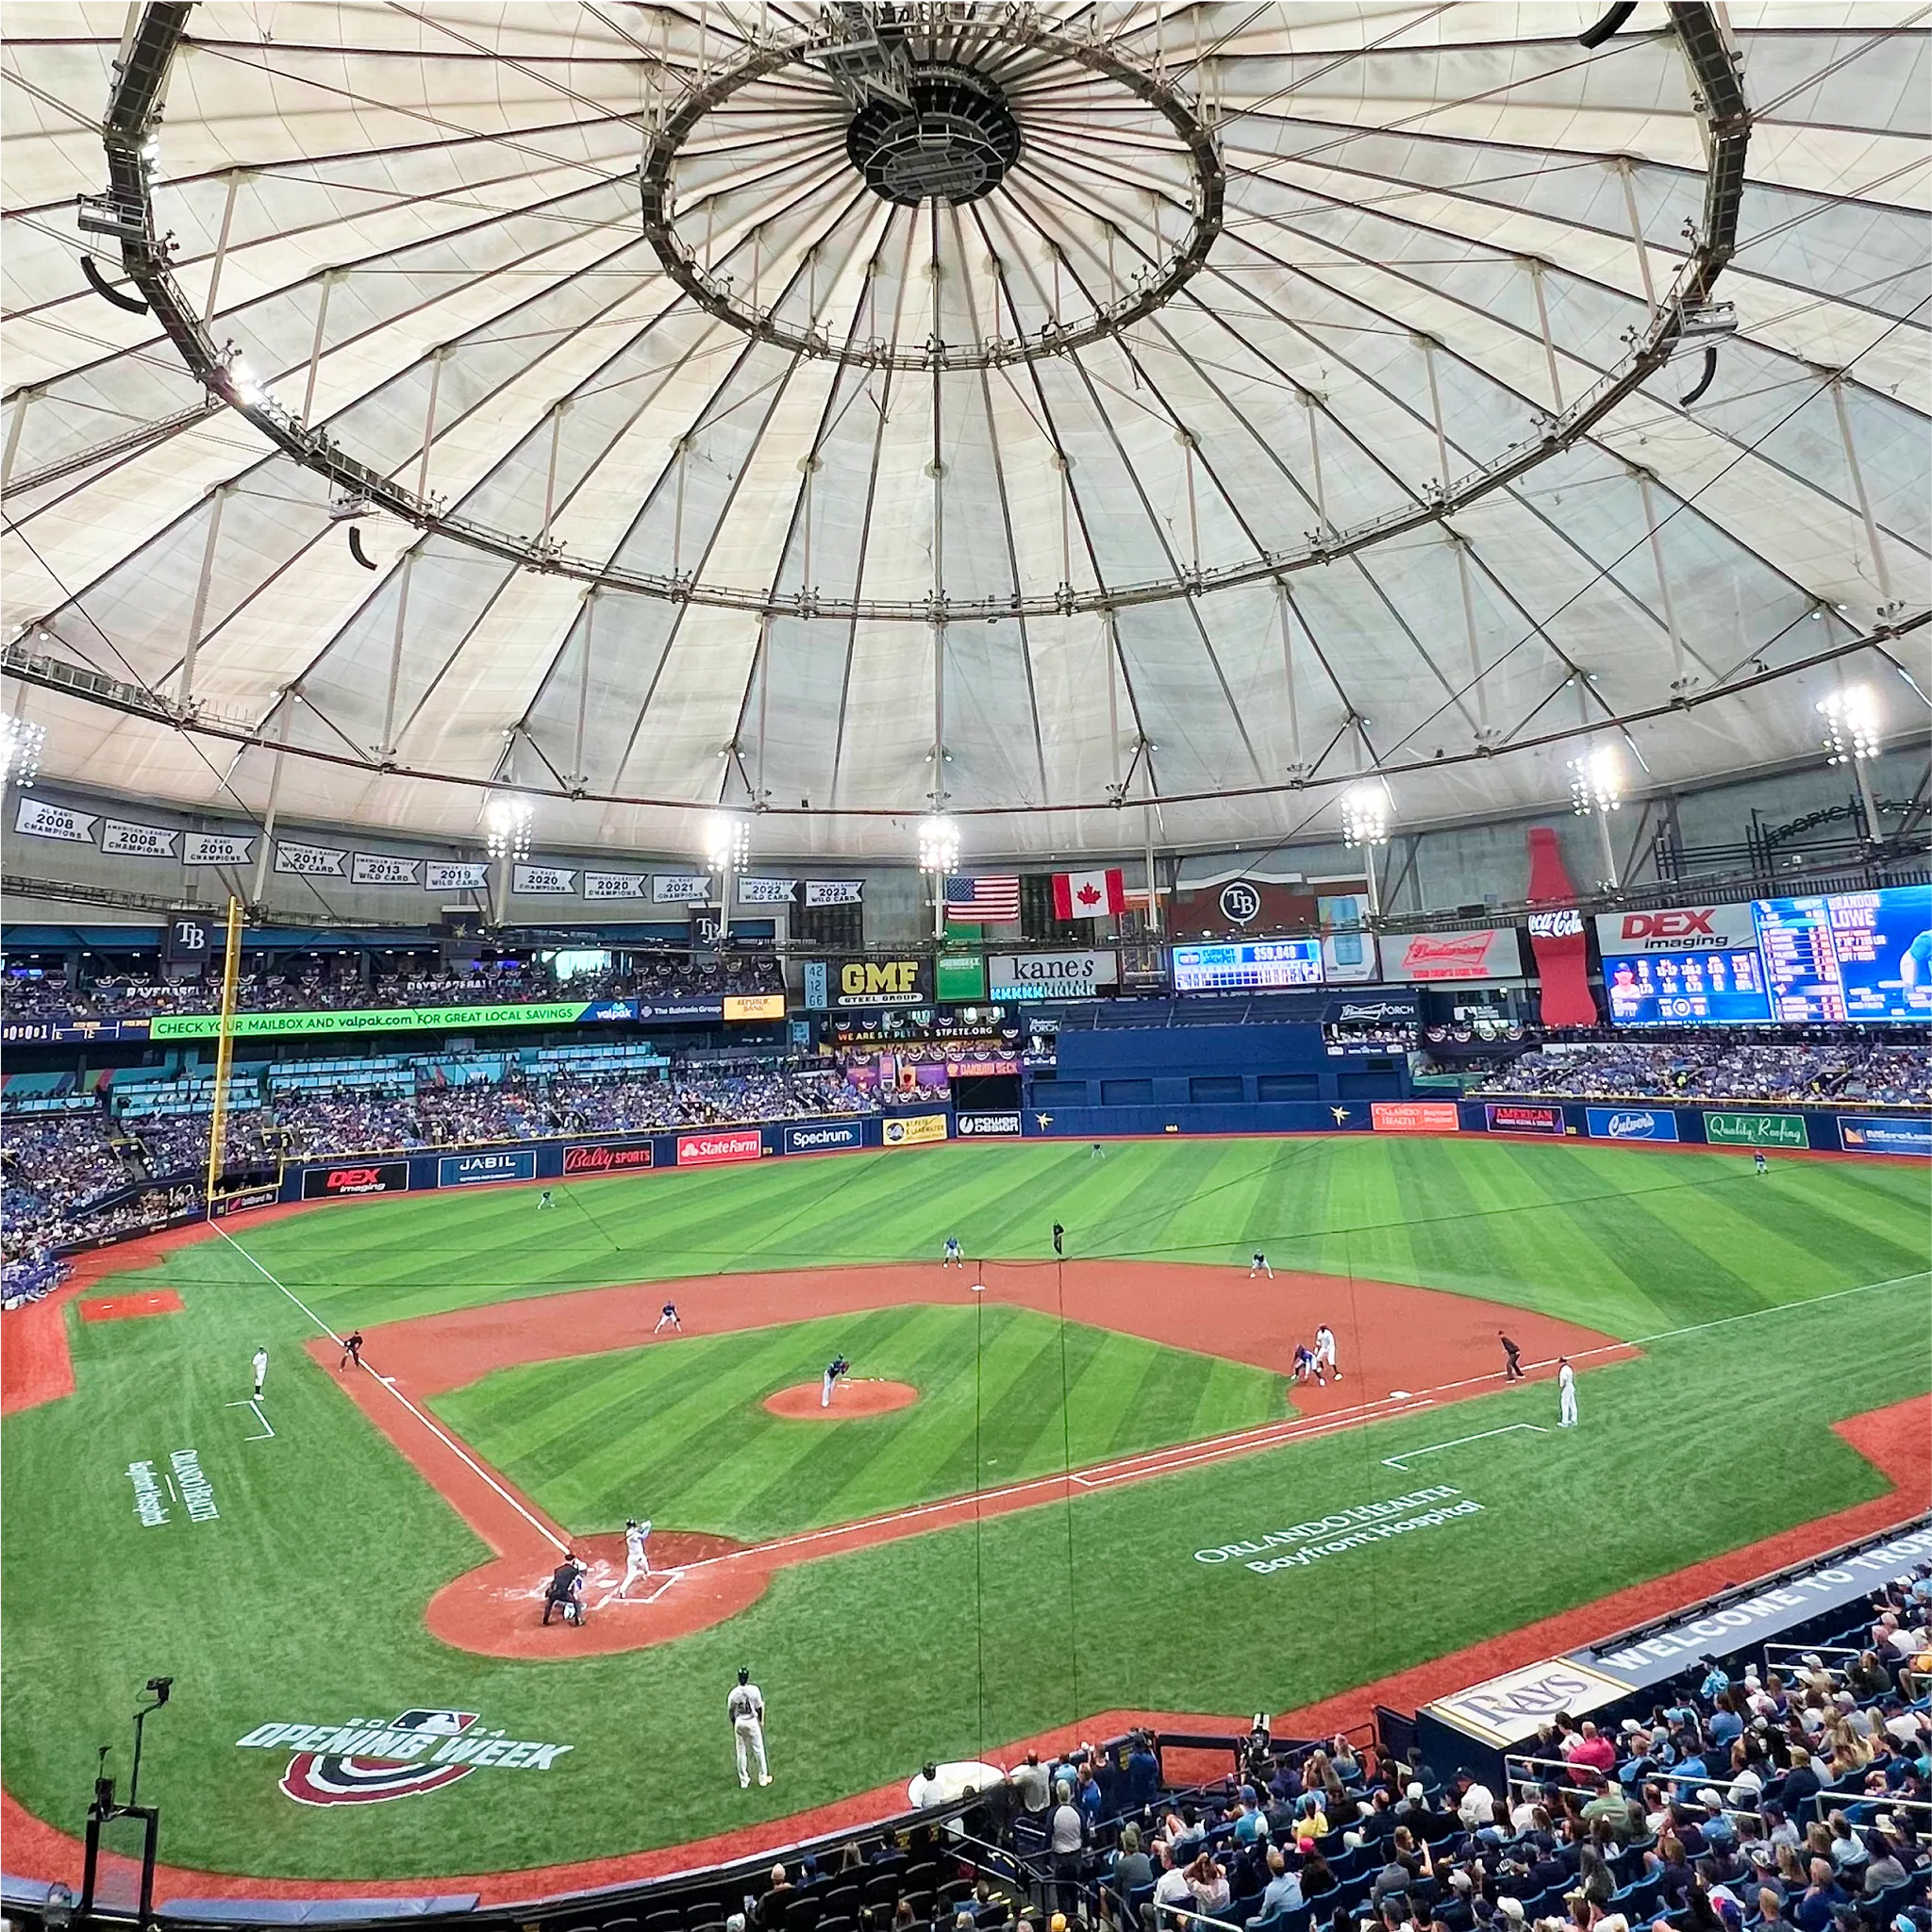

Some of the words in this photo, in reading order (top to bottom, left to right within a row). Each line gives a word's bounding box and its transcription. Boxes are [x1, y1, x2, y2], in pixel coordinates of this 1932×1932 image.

[36, 813, 74, 830] 2008
[24, 823, 82, 840] CHAMPIONS
[120, 832, 157, 846] 2008
[108, 841, 166, 855] CHAMPIONS
[200, 844, 234, 855] 2010
[191, 854, 242, 862] CHAMPIONS
[293, 853, 325, 865] 2011
[308, 864, 334, 874] CARD
[369, 865, 400, 875] 2013
[441, 870, 472, 879] 2019
[383, 874, 408, 882] CARD
[528, 874, 558, 885] 2020
[519, 884, 566, 892] CHAMPIONS
[597, 880, 628, 891] 2020
[666, 882, 694, 892] 2021
[753, 886, 781, 894] 2022
[819, 887, 847, 896] 2023
[1226, 891, 1255, 915] TB
[1827, 894, 1881, 911] BRANDON
[1621, 908, 1716, 940] DEX
[1830, 908, 1876, 928] LOWE
[175, 921, 206, 950] TB
[1644, 934, 1728, 949] imaging
[809, 965, 824, 977] 42
[1011, 957, 1094, 981] kane's
[841, 960, 919, 994] GMF
[810, 981, 821, 992] 12
[844, 994, 879, 1004] STEEL
[882, 994, 917, 1003] GROUP
[158, 1021, 202, 1034] CHECK
[247, 1018, 304, 1030] MAILBOX
[307, 1017, 334, 1028] AND
[338, 1014, 411, 1030] valpak.com
[417, 1013, 441, 1024] FOR
[444, 1010, 480, 1023] GREAT
[485, 1009, 526, 1021] LOCAL
[526, 1008, 574, 1019] SAVINGS
[596, 1008, 632, 1021] valpak
[838, 1033, 855, 1041] WE
[936, 1026, 992, 1037] STPETE.ORG
[974, 1117, 1018, 1125] POWER
[1496, 1108, 1553, 1121] AMERICAN
[1709, 1115, 1753, 1141] Quality
[1757, 1117, 1802, 1143] Roofing
[792, 1128, 850, 1149] Spectrum
[458, 1156, 516, 1170] JABIL
[566, 1147, 614, 1171] Bally
[614, 1149, 651, 1164] SPORTS
[326, 1168, 381, 1188] DEX
[340, 1183, 387, 1193] imaging
[1192, 1515, 1351, 1564] ORLANDO
[1342, 1484, 1462, 1524] HEALTH
[1245, 1532, 1379, 1575] Bayfront
[1374, 1498, 1487, 1538] Hospital
[1596, 1589, 1809, 1672] WELCOME
[1791, 1570, 1855, 1591] TO
[1452, 1674, 1589, 1726] RAYS
[236, 1723, 438, 1759] OPENING
[430, 1737, 575, 1771] WEEK
